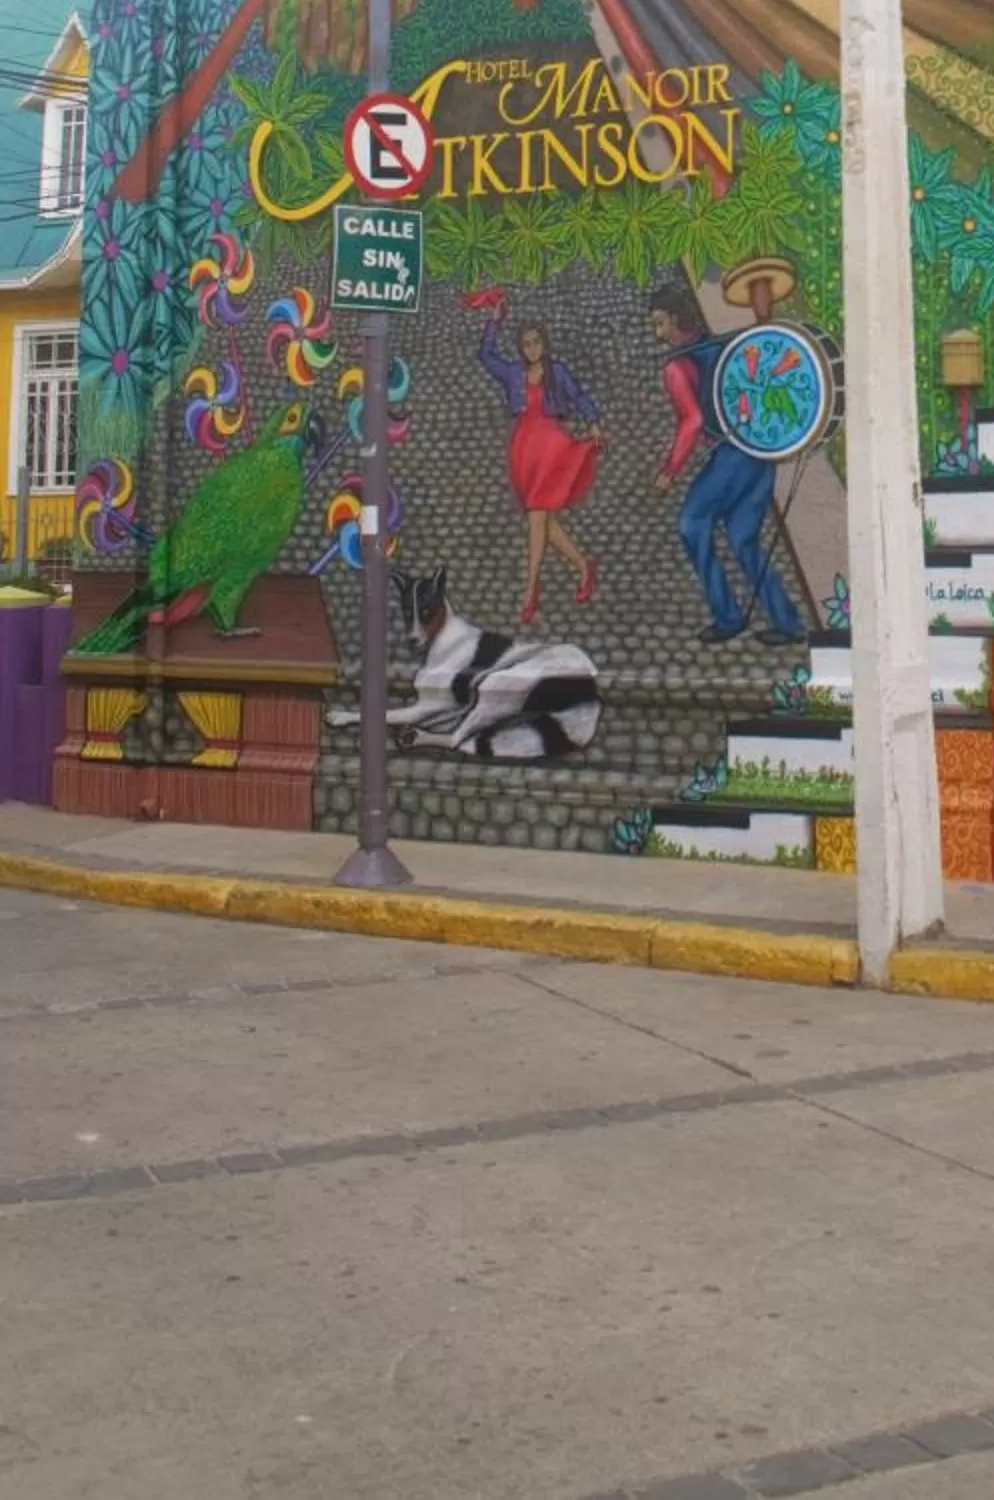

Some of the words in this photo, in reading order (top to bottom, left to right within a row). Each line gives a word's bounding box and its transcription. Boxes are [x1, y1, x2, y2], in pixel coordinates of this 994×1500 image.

[465, 59, 532, 84] HOTEL
[499, 58, 733, 126] MANOIR
[343, 217, 415, 239] CALLE
[362, 249, 401, 269] SIN
